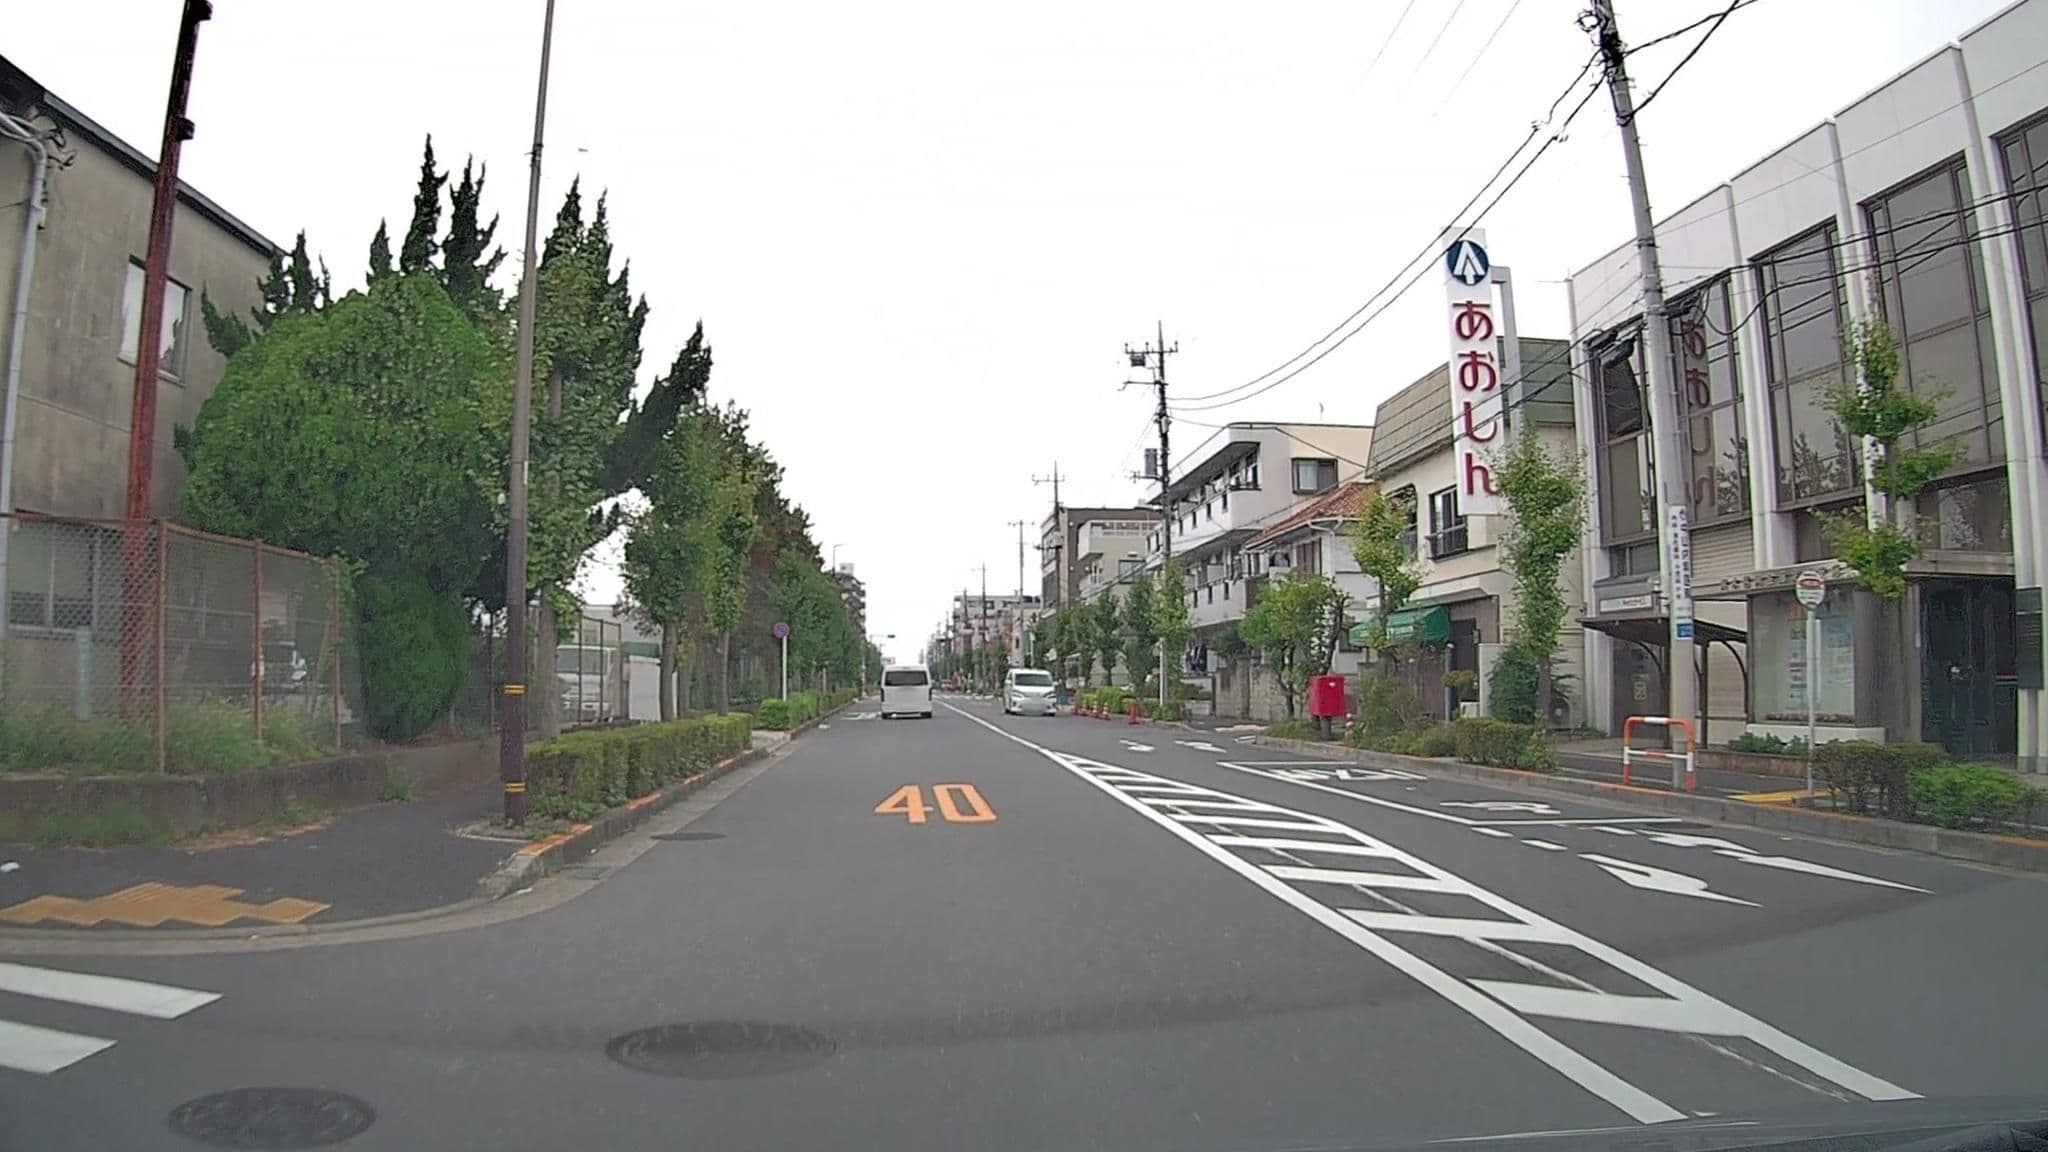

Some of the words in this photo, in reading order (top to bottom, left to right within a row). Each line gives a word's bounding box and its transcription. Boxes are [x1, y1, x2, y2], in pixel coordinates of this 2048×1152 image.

[1451, 300, 1499, 496] あおしん
[874, 784, 997, 823] 40
